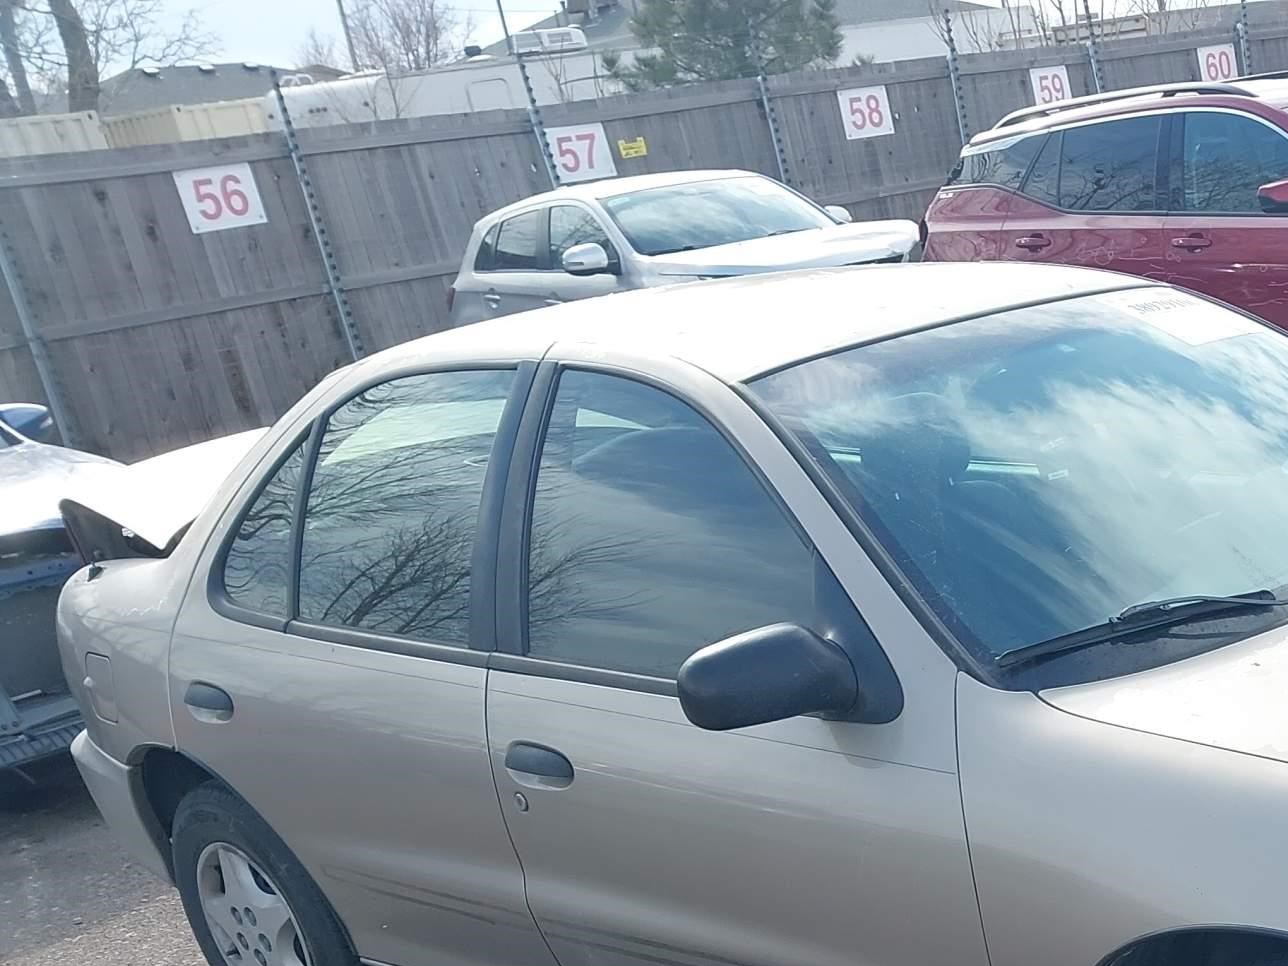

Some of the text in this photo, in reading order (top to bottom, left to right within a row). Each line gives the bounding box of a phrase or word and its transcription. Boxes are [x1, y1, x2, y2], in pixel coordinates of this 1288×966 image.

[1206, 51, 1231, 81] 60
[1039, 73, 1065, 104] 59
[848, 94, 884, 130] 58
[556, 132, 596, 173] 57
[192, 174, 249, 221] 56
